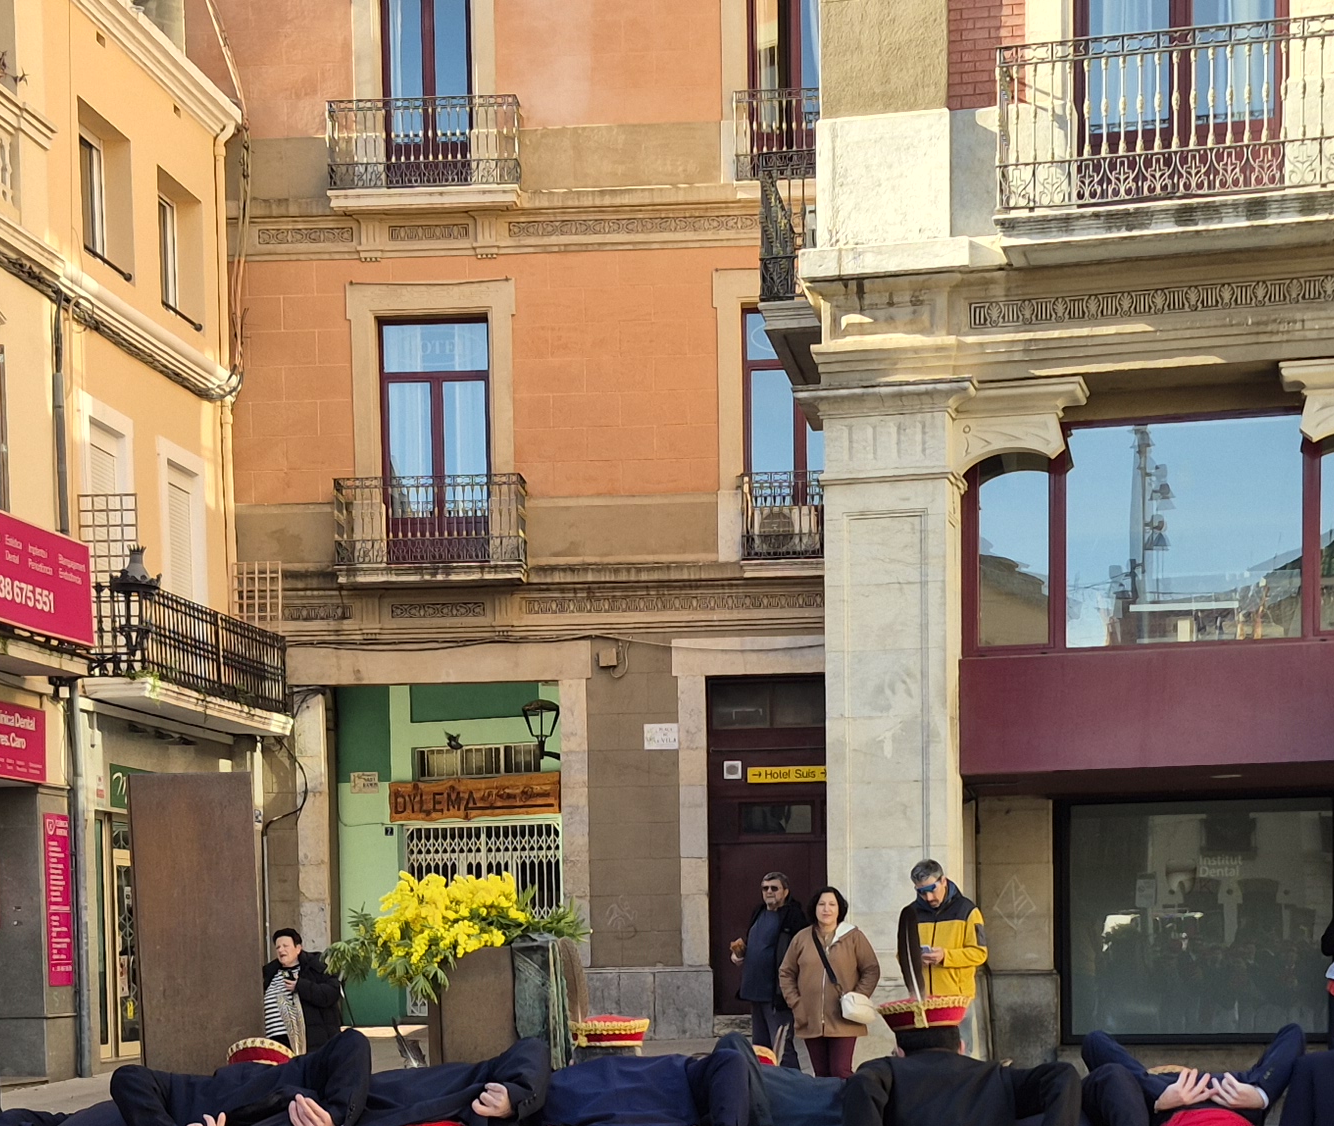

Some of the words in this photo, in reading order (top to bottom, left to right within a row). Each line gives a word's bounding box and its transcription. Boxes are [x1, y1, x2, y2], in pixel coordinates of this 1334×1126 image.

[13, 580, 35, 608] 675
[34, 587, 55, 614] 551
[764, 768, 791, 780] Hotel
[394, 790, 478, 816] DYLEMA
[1198, 866, 1240, 878] Dental
